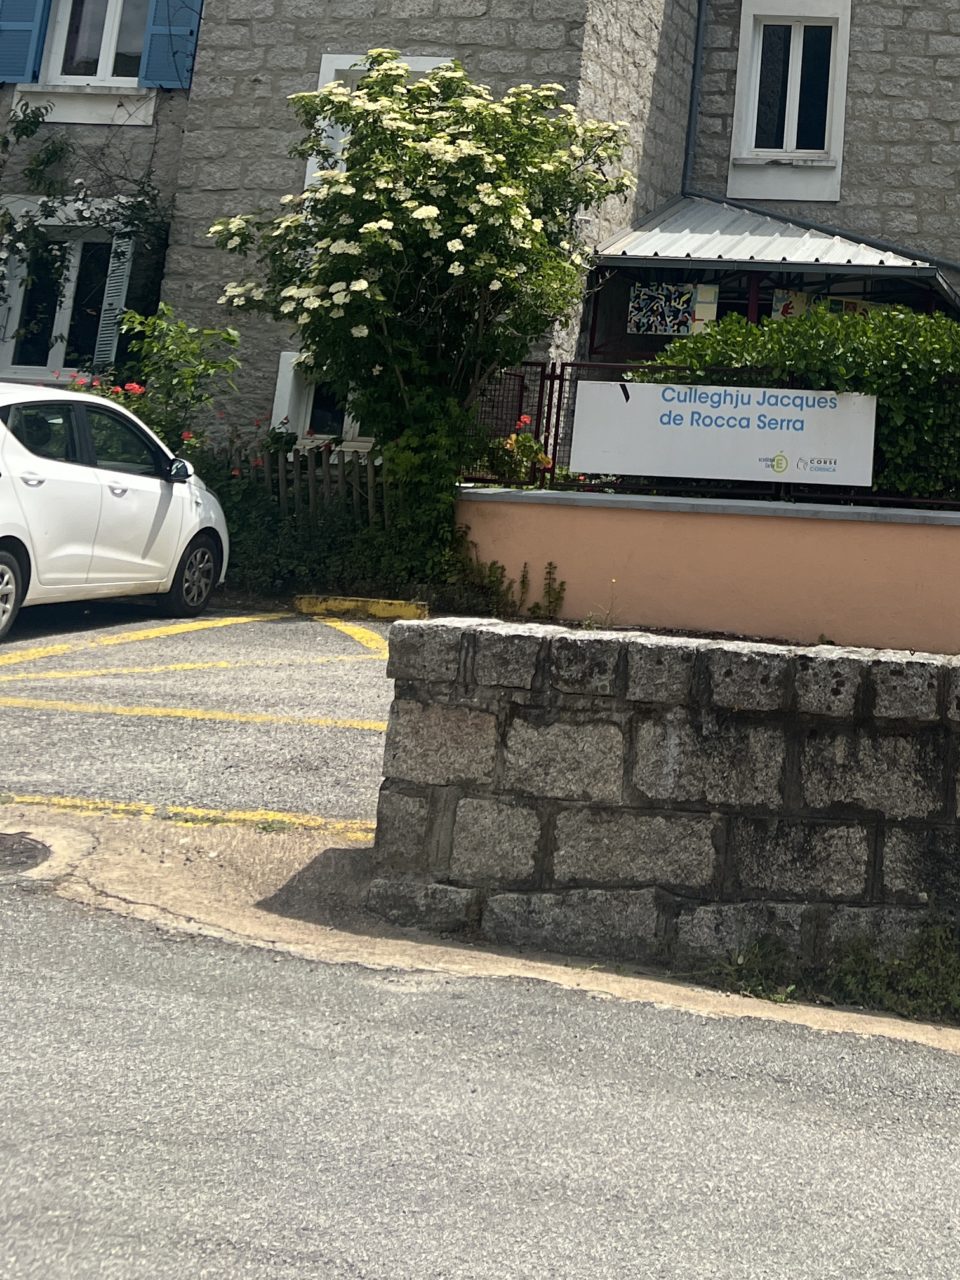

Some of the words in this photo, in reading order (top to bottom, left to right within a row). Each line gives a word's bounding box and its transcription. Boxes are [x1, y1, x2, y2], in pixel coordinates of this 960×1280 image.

[660, 386, 751, 409] Culleghju
[756, 390, 838, 411] Jacques
[659, 410, 684, 426] de
[690, 411, 750, 429] Rocca
[756, 413, 805, 431] Serra
